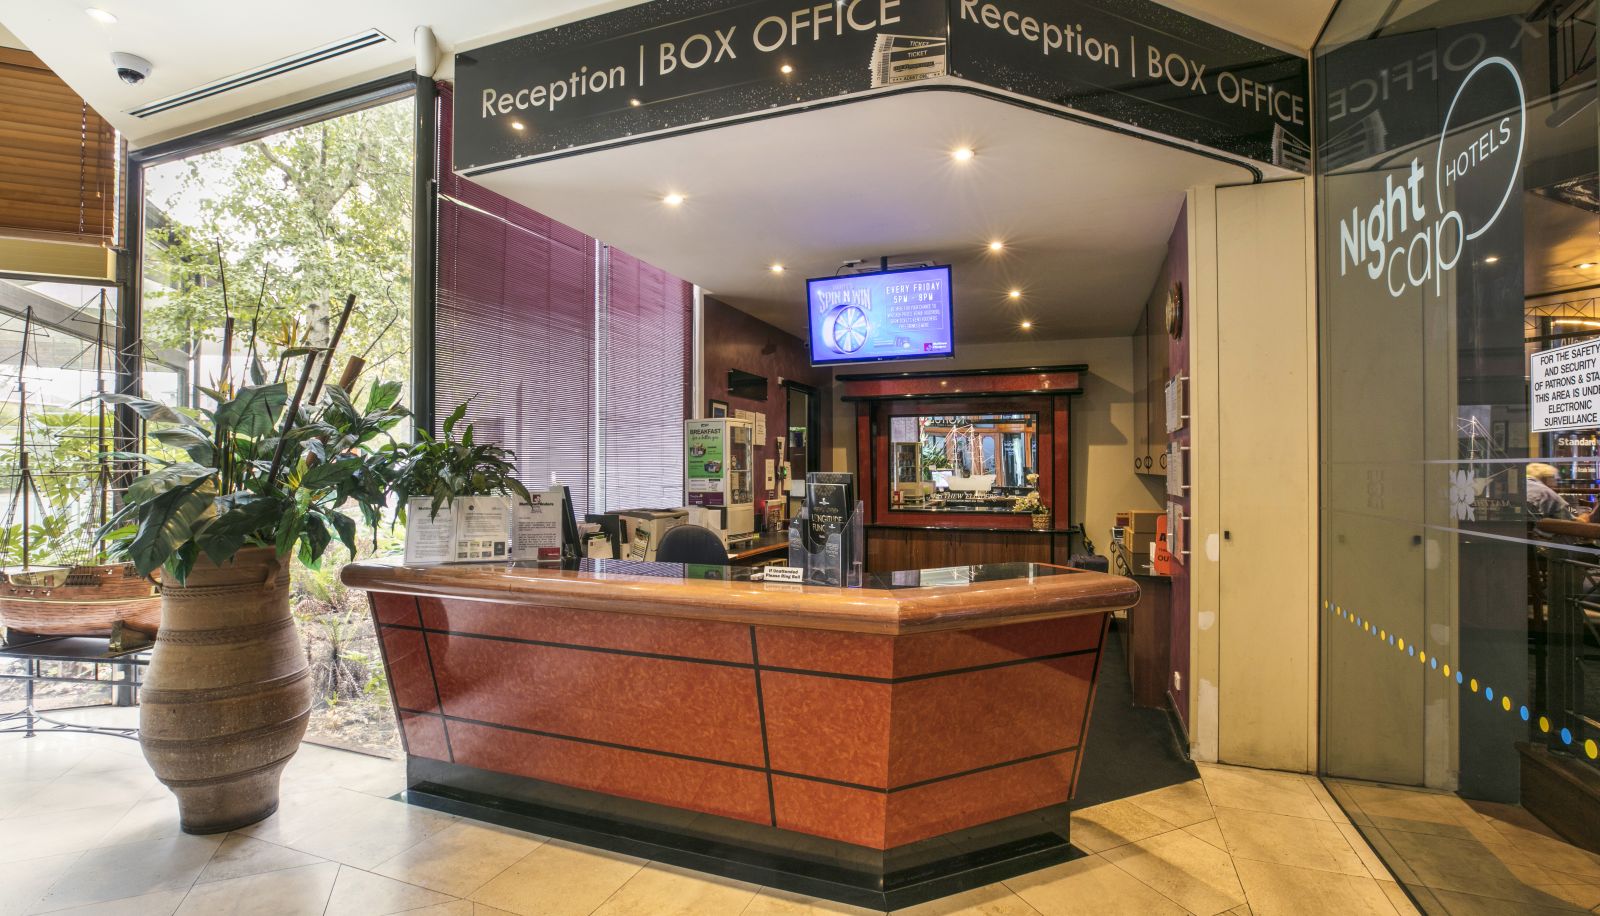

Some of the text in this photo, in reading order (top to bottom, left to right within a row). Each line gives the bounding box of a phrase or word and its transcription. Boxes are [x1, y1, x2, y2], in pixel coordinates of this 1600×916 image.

[482, 0, 900, 118] Reception BOX OFFICE
[907, 50, 929, 58] TICKET
[960, 0, 1304, 126] Reception BOX OFFICE
[1445, 117, 1511, 188] HOTELS
[1340, 156, 1425, 280] Night
[1388, 210, 1464, 298] cap
[886, 281, 940, 295] EVERY FRIDAY
[816, 289, 840, 313] SPIN
[843, 290, 851, 303] N
[851, 287, 871, 310] WIN
[893, 295, 908, 304] 5PM
[1540, 343, 1600, 366] FOR THE SAFETY
[1544, 358, 1596, 377] AND SECURITY
[1534, 381, 1543, 391] OF
[1545, 375, 1576, 389] PATRONS
[1578, 374, 1584, 384] &
[1535, 392, 1549, 403] THIS
[1551, 389, 1571, 401] AREA
[1573, 388, 1580, 398] IS
[1548, 399, 1592, 414] ELECTRONIC
[1544, 412, 1597, 427] SURVEILLANCE
[1558, 437, 1597, 446] Standard
